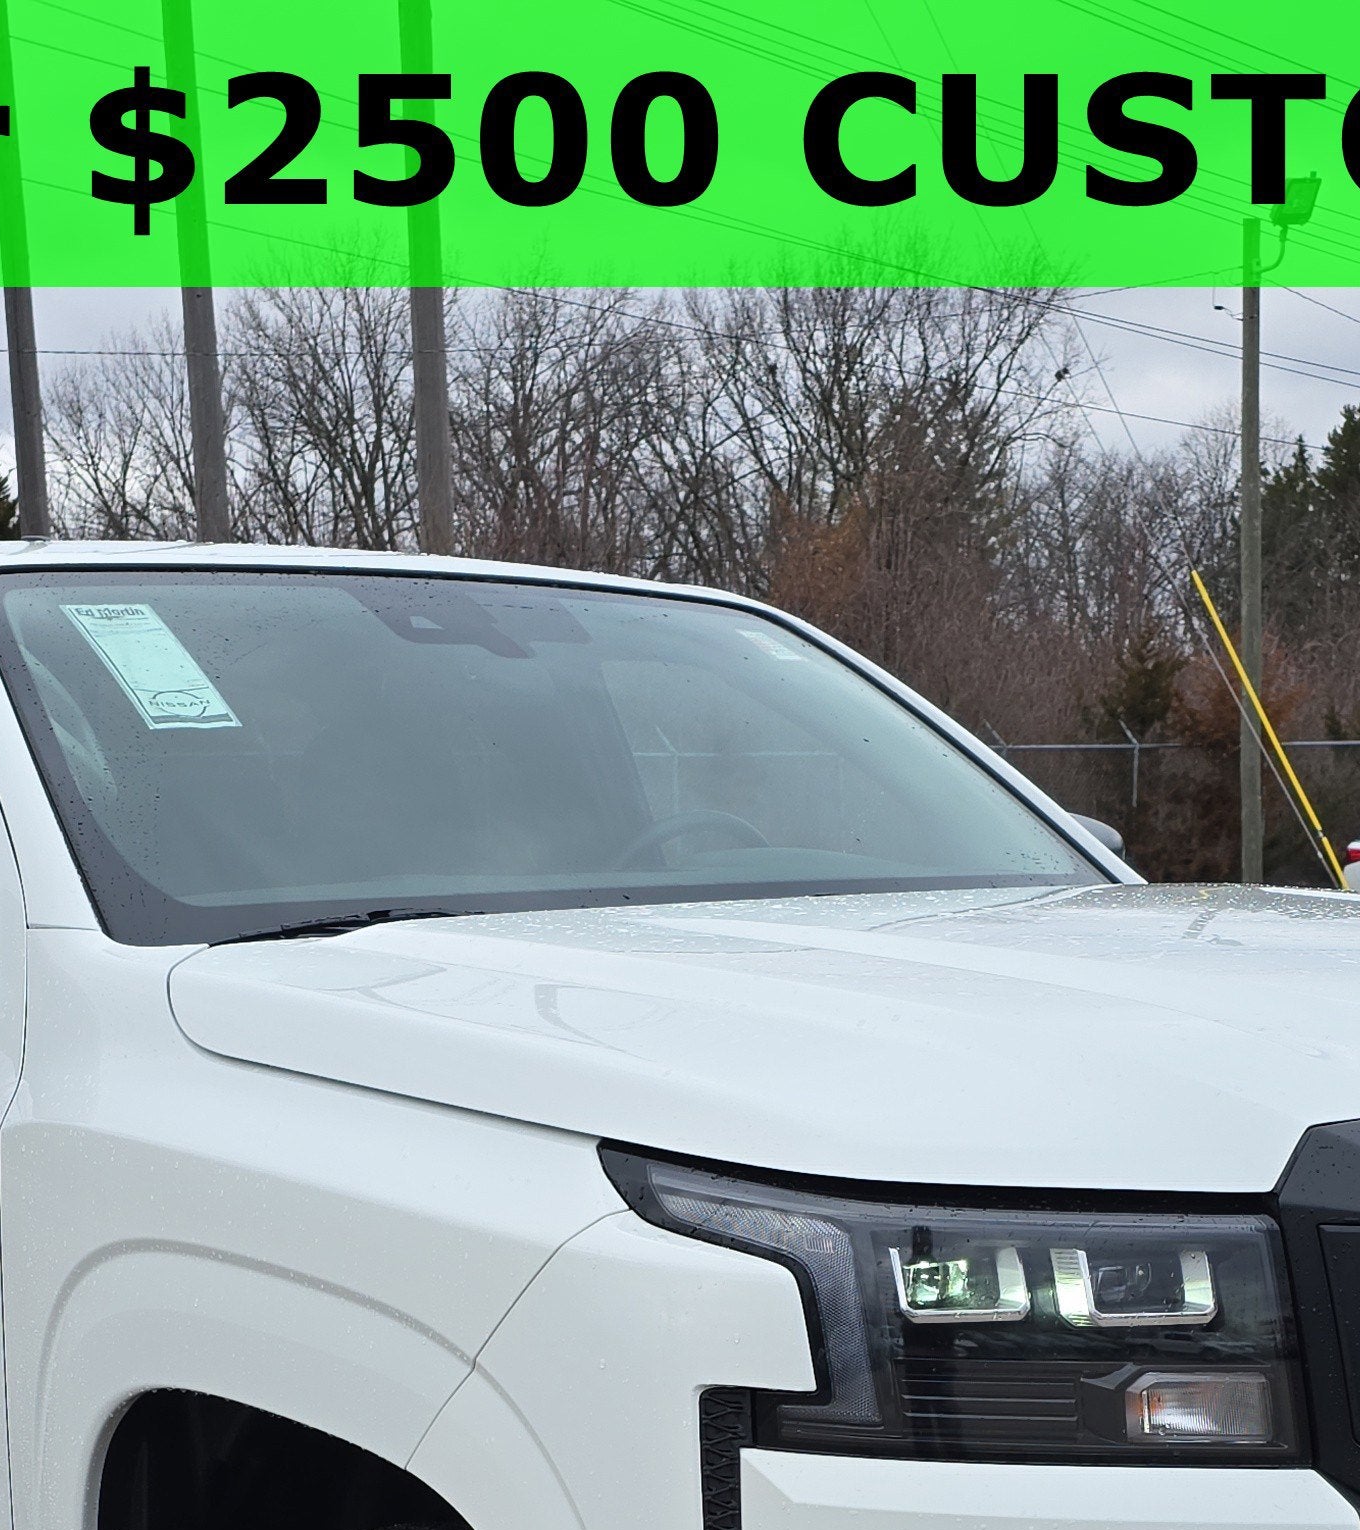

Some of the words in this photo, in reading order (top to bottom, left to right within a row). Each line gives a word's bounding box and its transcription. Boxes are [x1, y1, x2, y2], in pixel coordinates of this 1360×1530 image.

[74, 607, 95, 617] Ed
[95, 606, 145, 618] Martin
[148, 699, 210, 708] NISSAN
